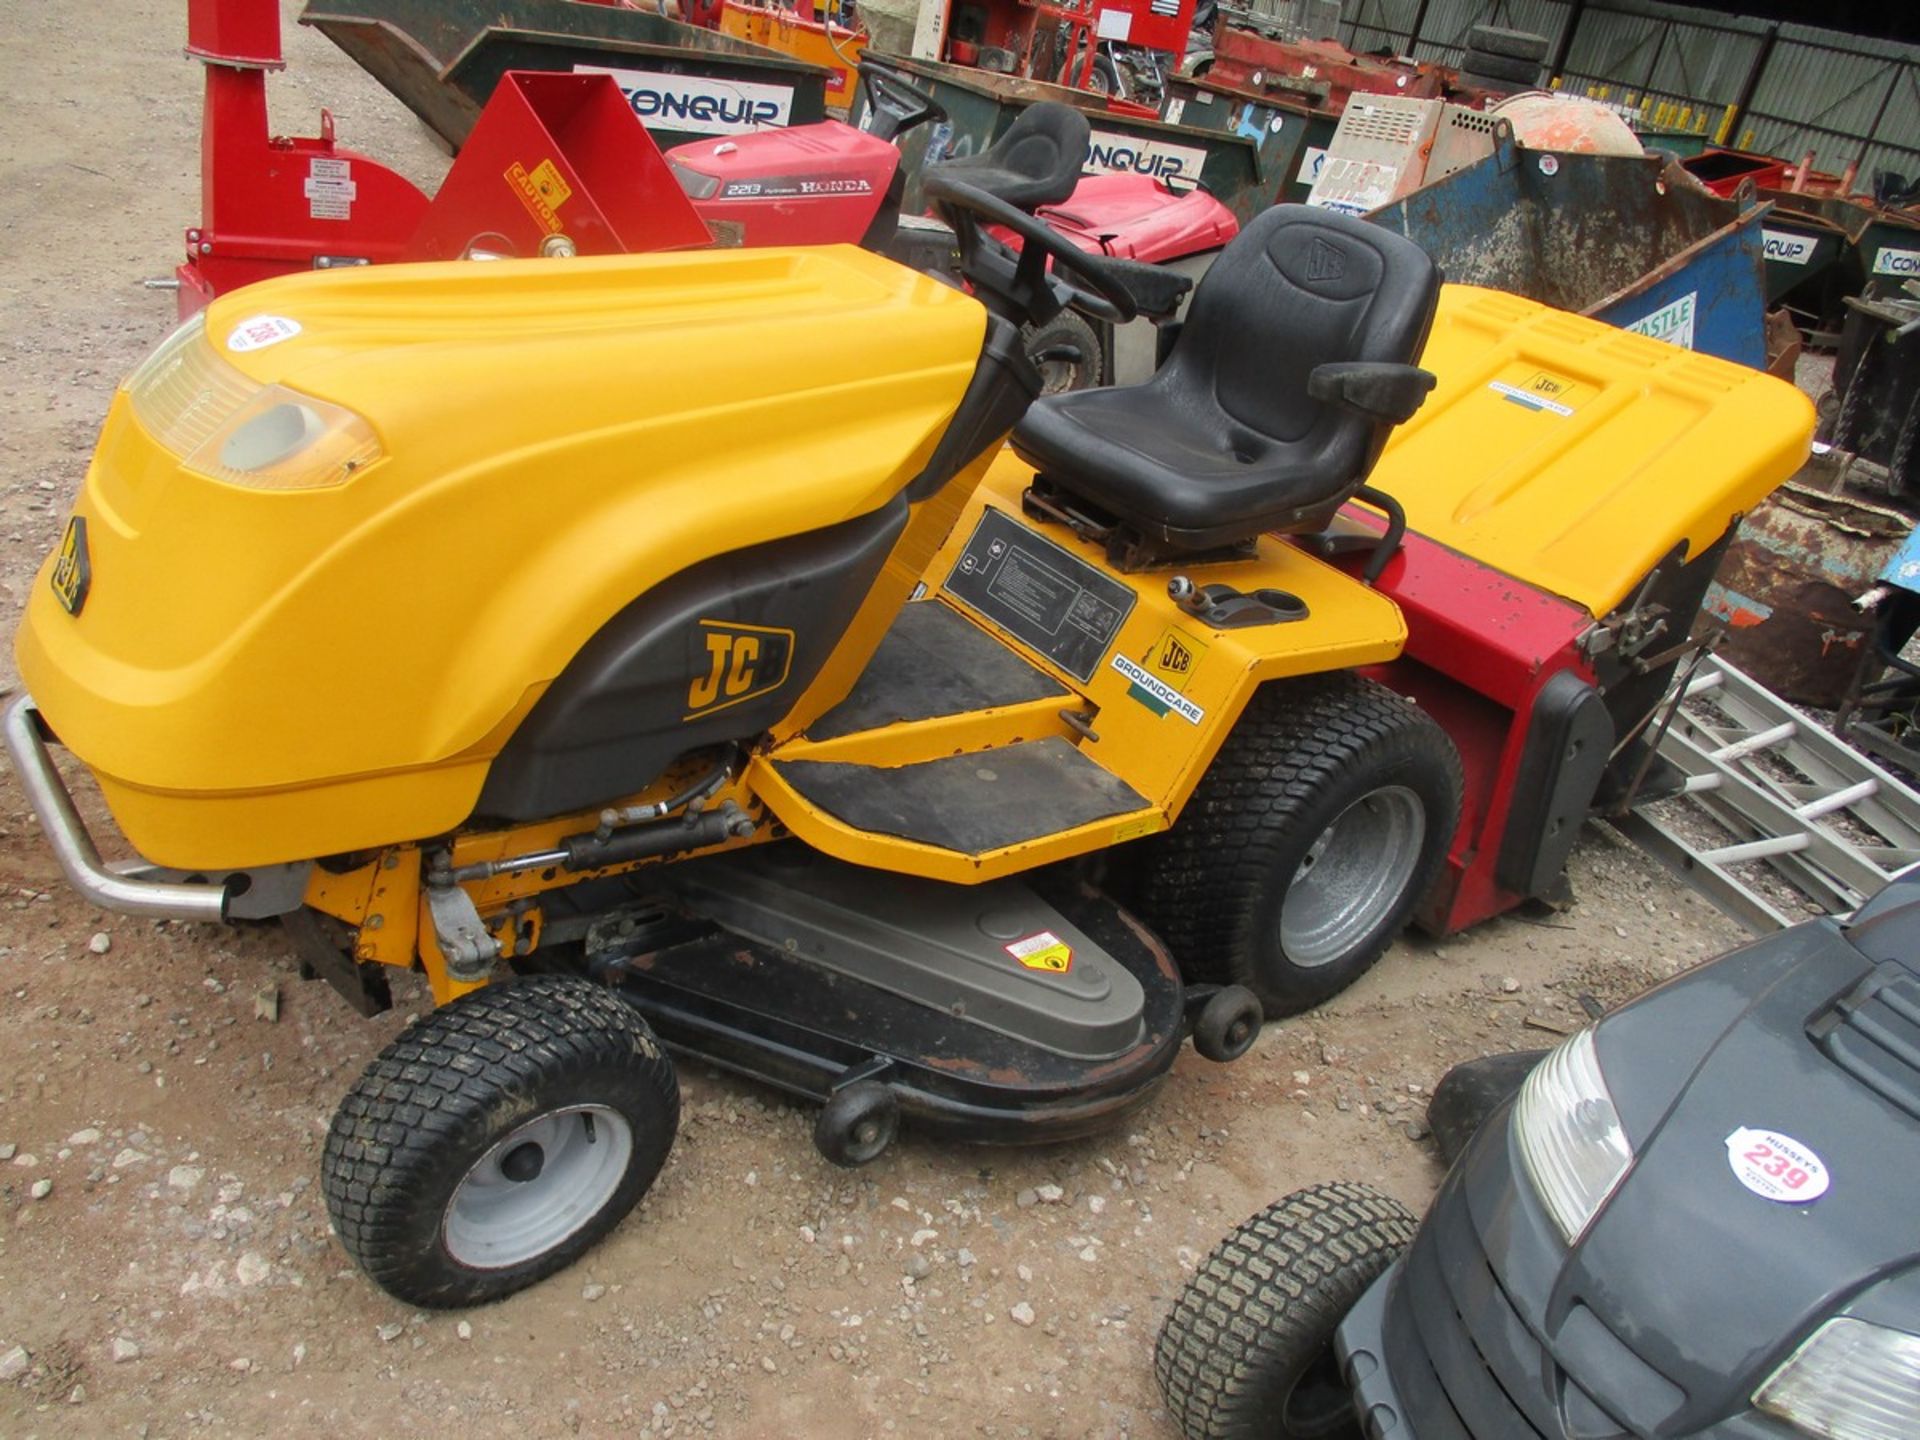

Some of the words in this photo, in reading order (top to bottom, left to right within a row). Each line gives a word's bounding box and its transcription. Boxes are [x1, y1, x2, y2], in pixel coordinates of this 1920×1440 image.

[621, 87, 779, 126] ONQUIP
[1088, 142, 1183, 178] NQUIP
[512, 167, 561, 232] CAUTION
[800, 180, 871, 193] HONDA
[1631, 300, 1690, 338] ASTLE
[1162, 640, 1190, 671] JCB
[1114, 657, 1200, 721] GROUNDCARE
[1743, 1143, 1809, 1190] 239
[1766, 1136, 1818, 1174] HUSSEYS
